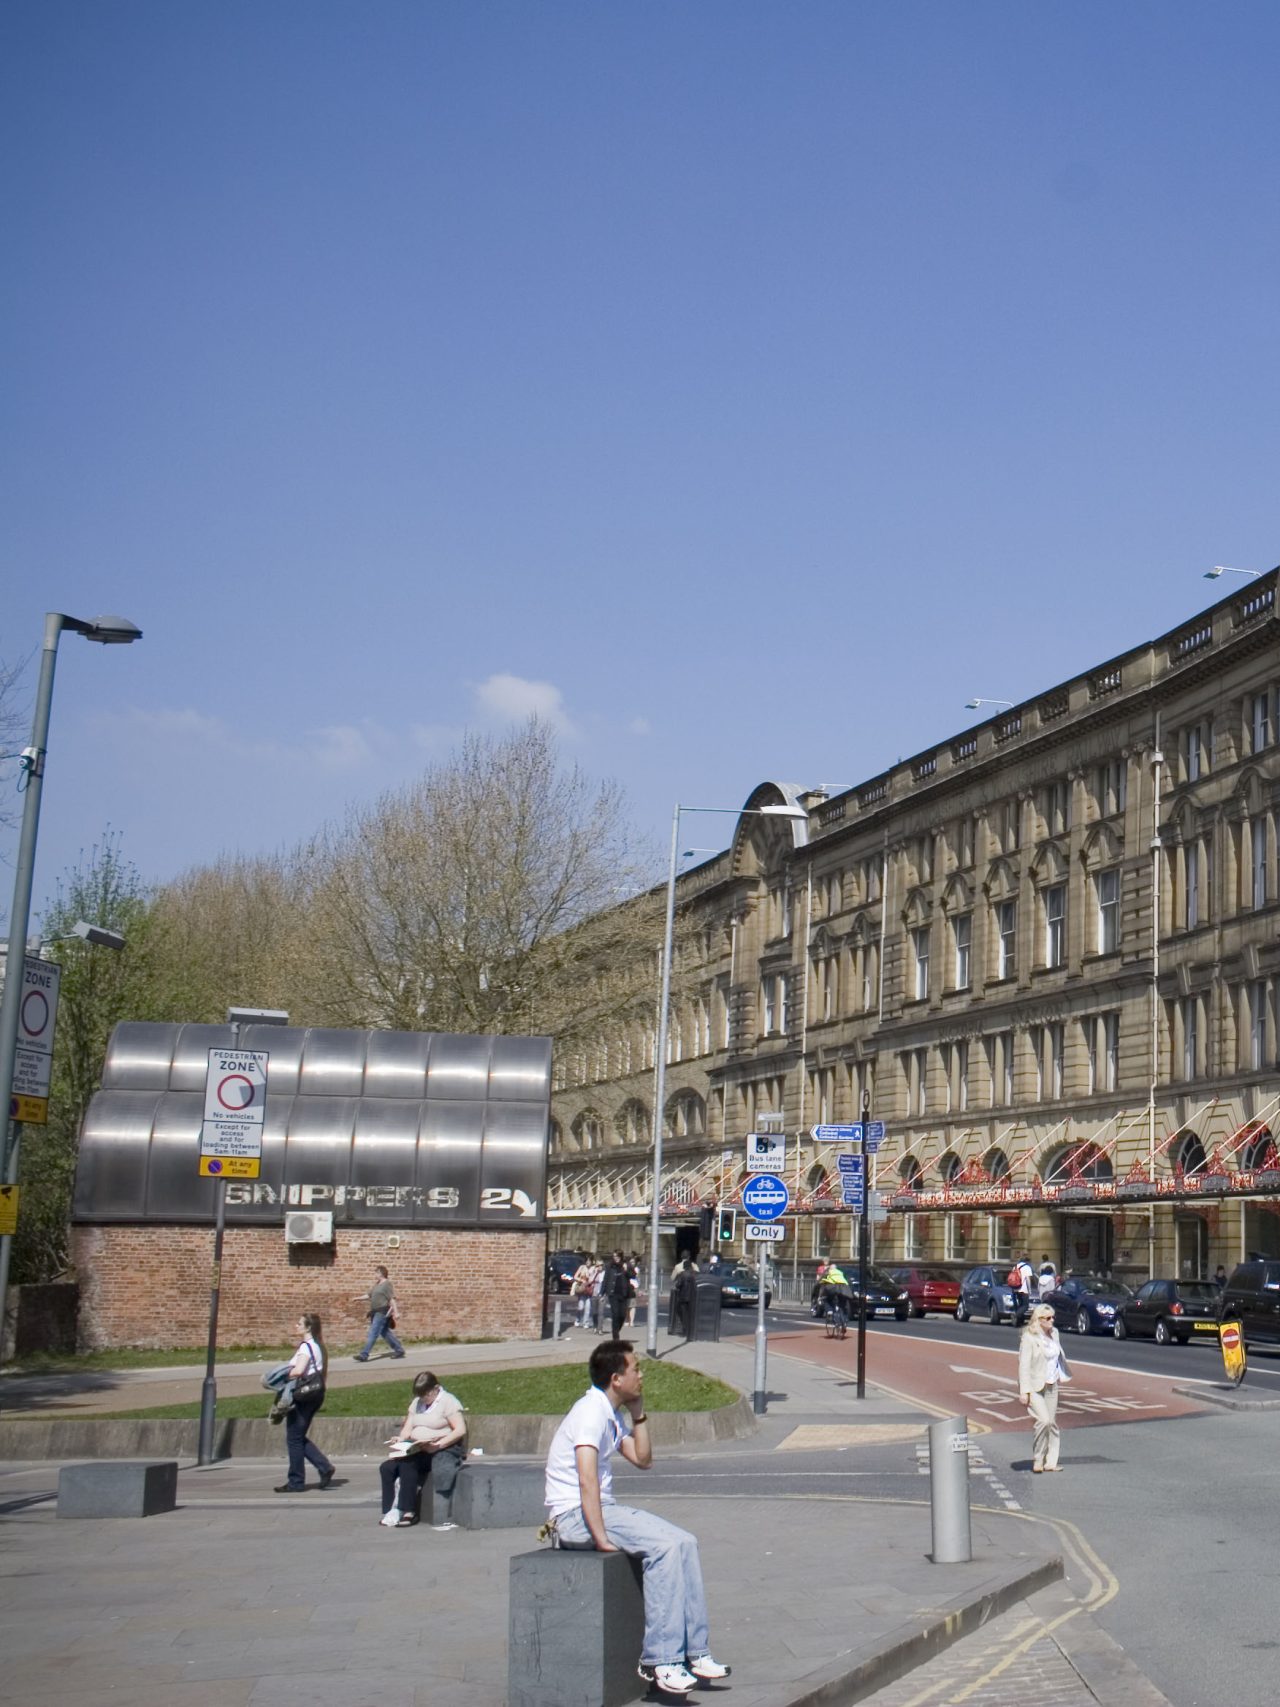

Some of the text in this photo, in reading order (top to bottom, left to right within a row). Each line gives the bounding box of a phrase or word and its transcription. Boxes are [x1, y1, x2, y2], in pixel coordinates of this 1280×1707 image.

[25, 971, 52, 988] ZONE
[214, 1052, 263, 1060] PEDESTRIAN
[220, 1061, 255, 1071] ZONE
[481, 1188, 512, 1209] 2
[751, 1226, 779, 1238] Only
